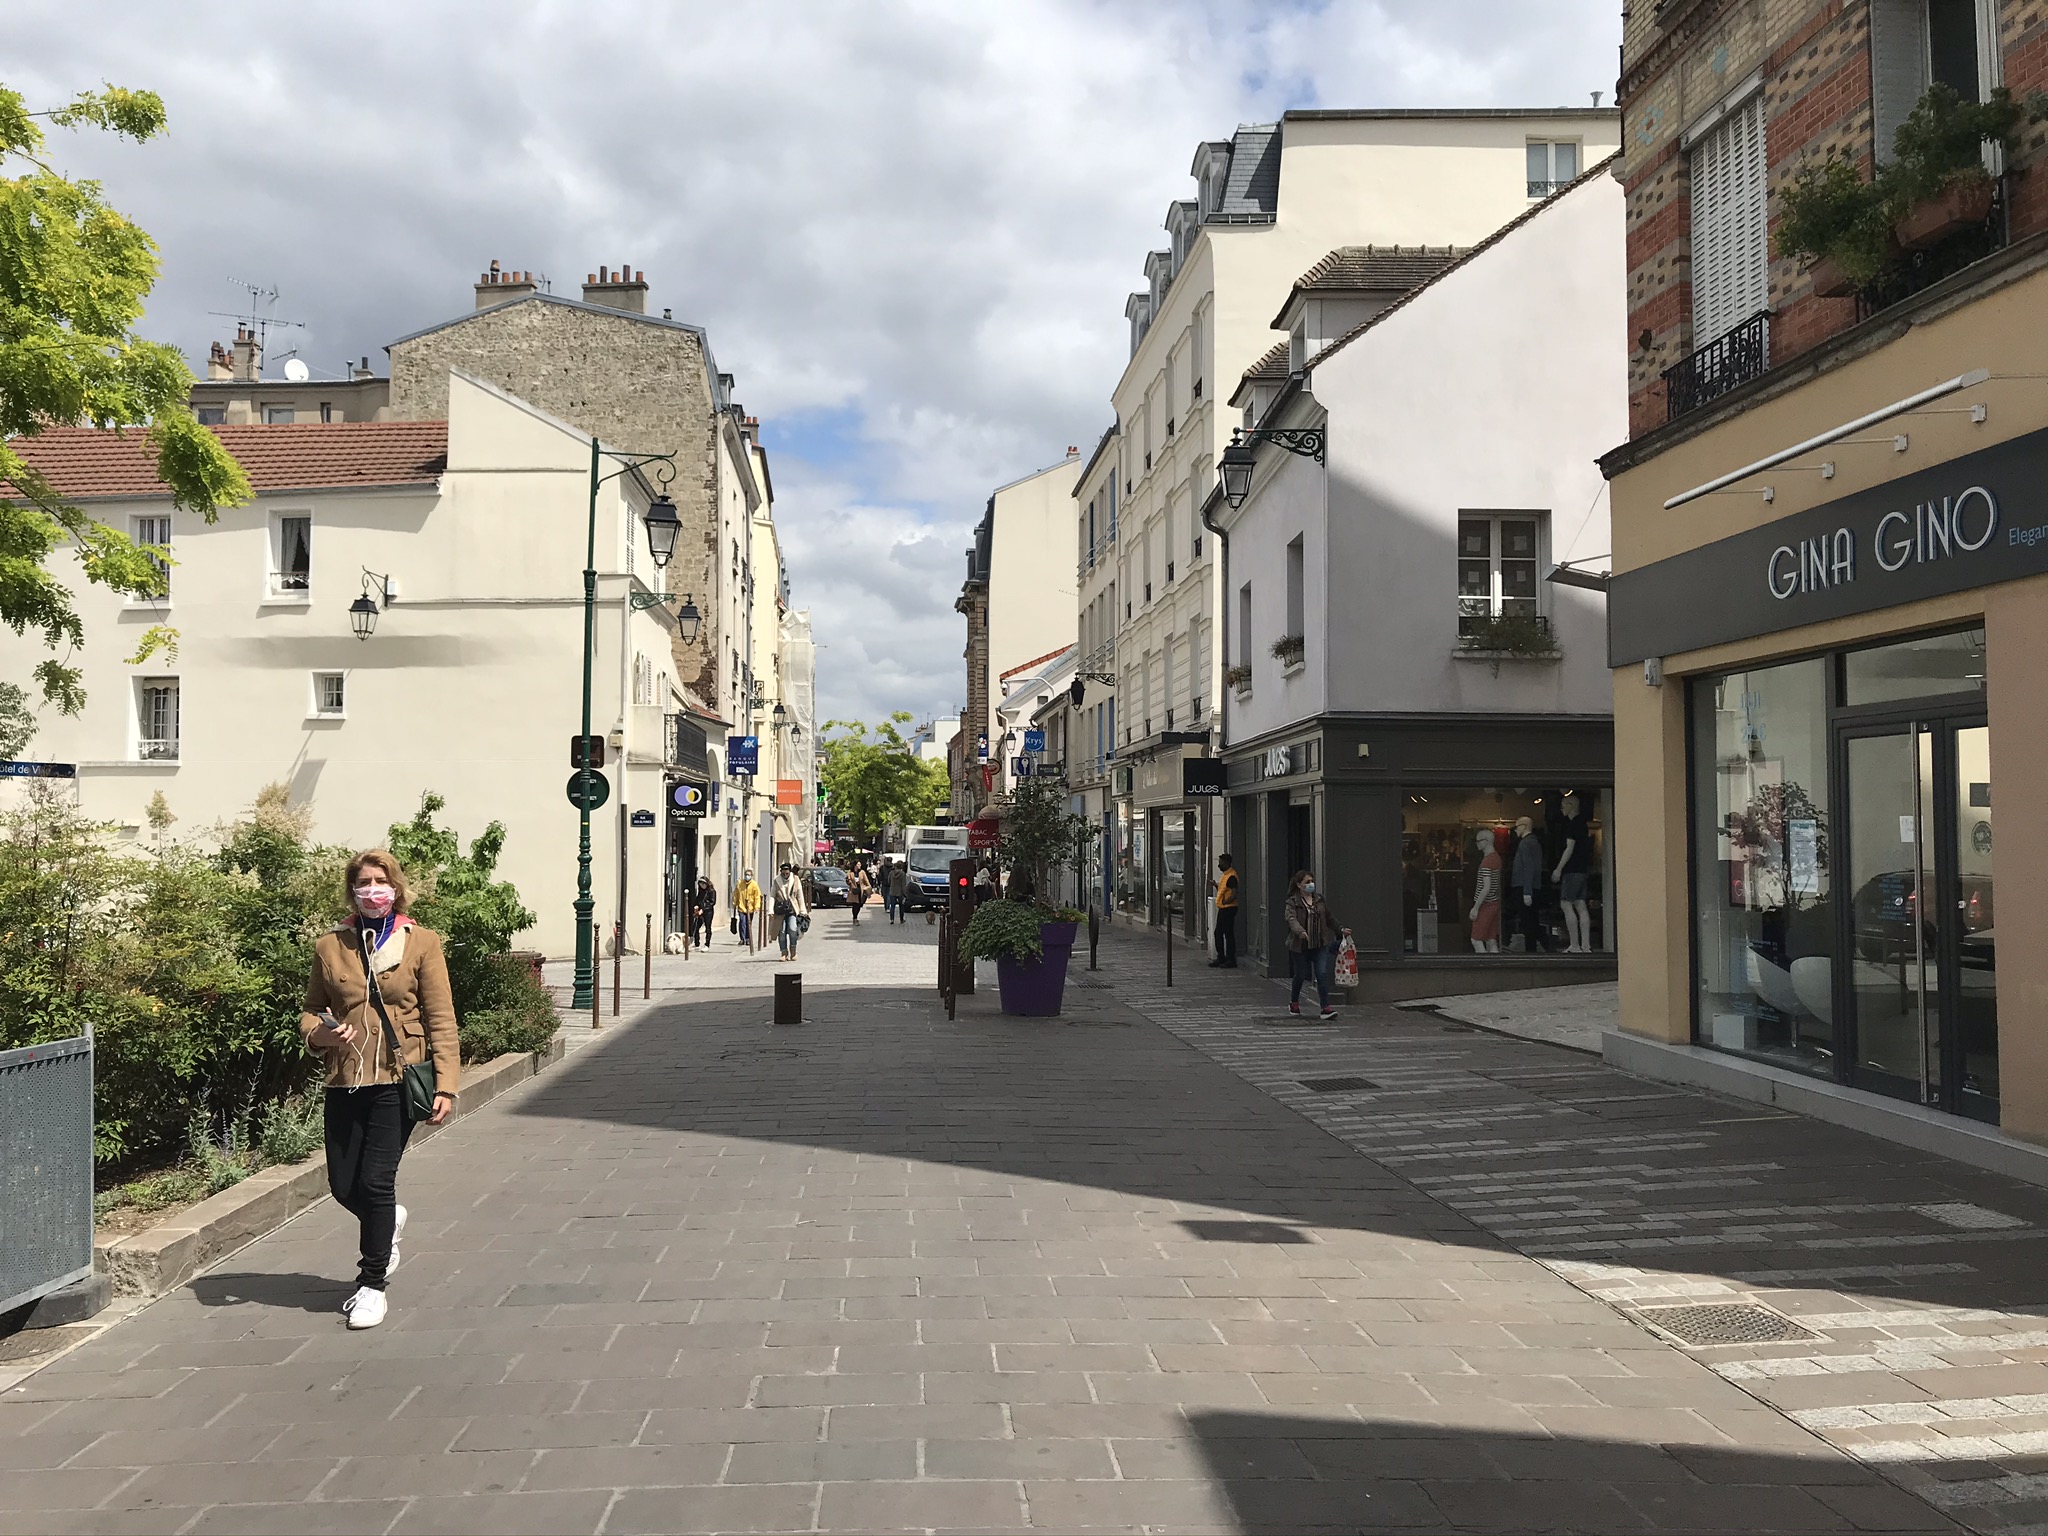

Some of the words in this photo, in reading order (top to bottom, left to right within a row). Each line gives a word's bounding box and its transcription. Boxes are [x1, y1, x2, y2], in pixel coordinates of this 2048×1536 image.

[1768, 527, 1855, 600] GINA
[1874, 486, 1999, 572] GINO
[1025, 736, 1043, 746] Krys
[17, 764, 30, 774] de
